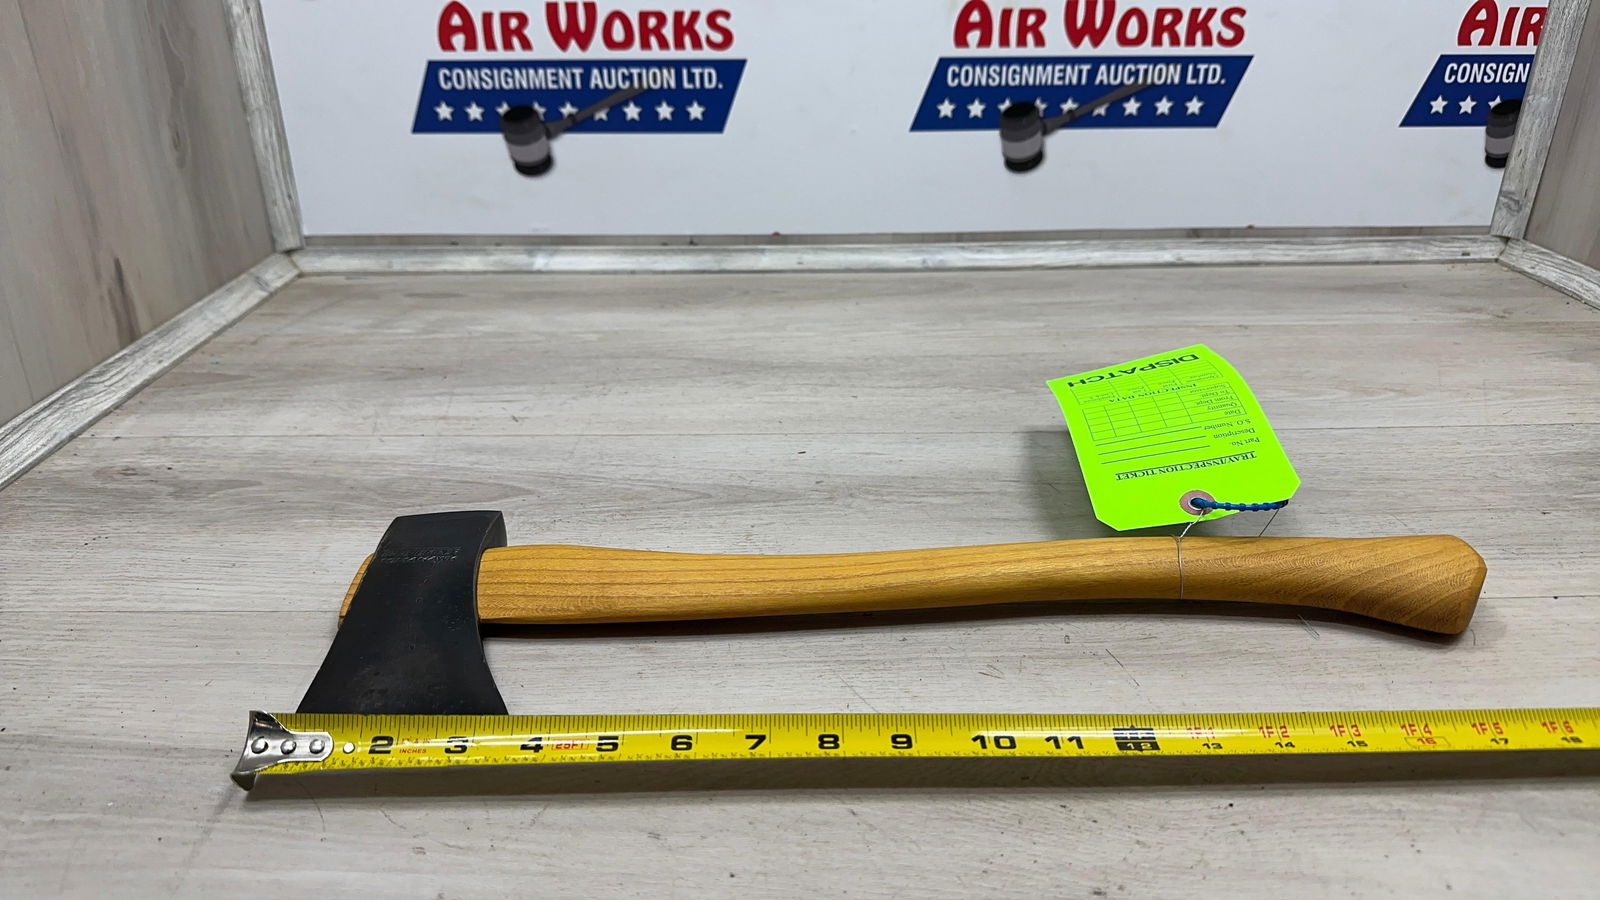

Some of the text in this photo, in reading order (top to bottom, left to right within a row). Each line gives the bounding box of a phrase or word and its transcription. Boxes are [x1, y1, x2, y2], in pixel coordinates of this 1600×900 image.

[546, 1, 734, 52] WORKS
[1064, 0, 1247, 48] WORKS
[438, 67, 723, 90] CONSIGNMENT AUCTION LTD.
[946, 63, 1226, 87] CONSIGNMENT AUCTION LTD.
[1444, 63, 1530, 83] CONSIGN
[1067, 354, 1199, 387] DISPATCH
[1207, 402, 1237, 411] Quantity
[1204, 421, 1233, 430] Number
[1213, 427, 1256, 439] Description
[1115, 467, 1157, 481] TICKET
[368, 736, 393, 754] 2
[444, 736, 469, 754] 3
[520, 736, 544, 753] 4
[596, 735, 619, 752] 5
[671, 735, 693, 751] 6
[745, 735, 767, 750] 7
[818, 734, 841, 750] 8
[891, 734, 913, 750] 9
[971, 735, 1017, 750] 10
[1044, 735, 1085, 750] 11
[1202, 742, 1223, 750] 13
[1275, 741, 1296, 749] 14
[1346, 740, 1369, 748] 15
[1416, 737, 1437, 745] 16
[1489, 738, 1509, 746] 17
